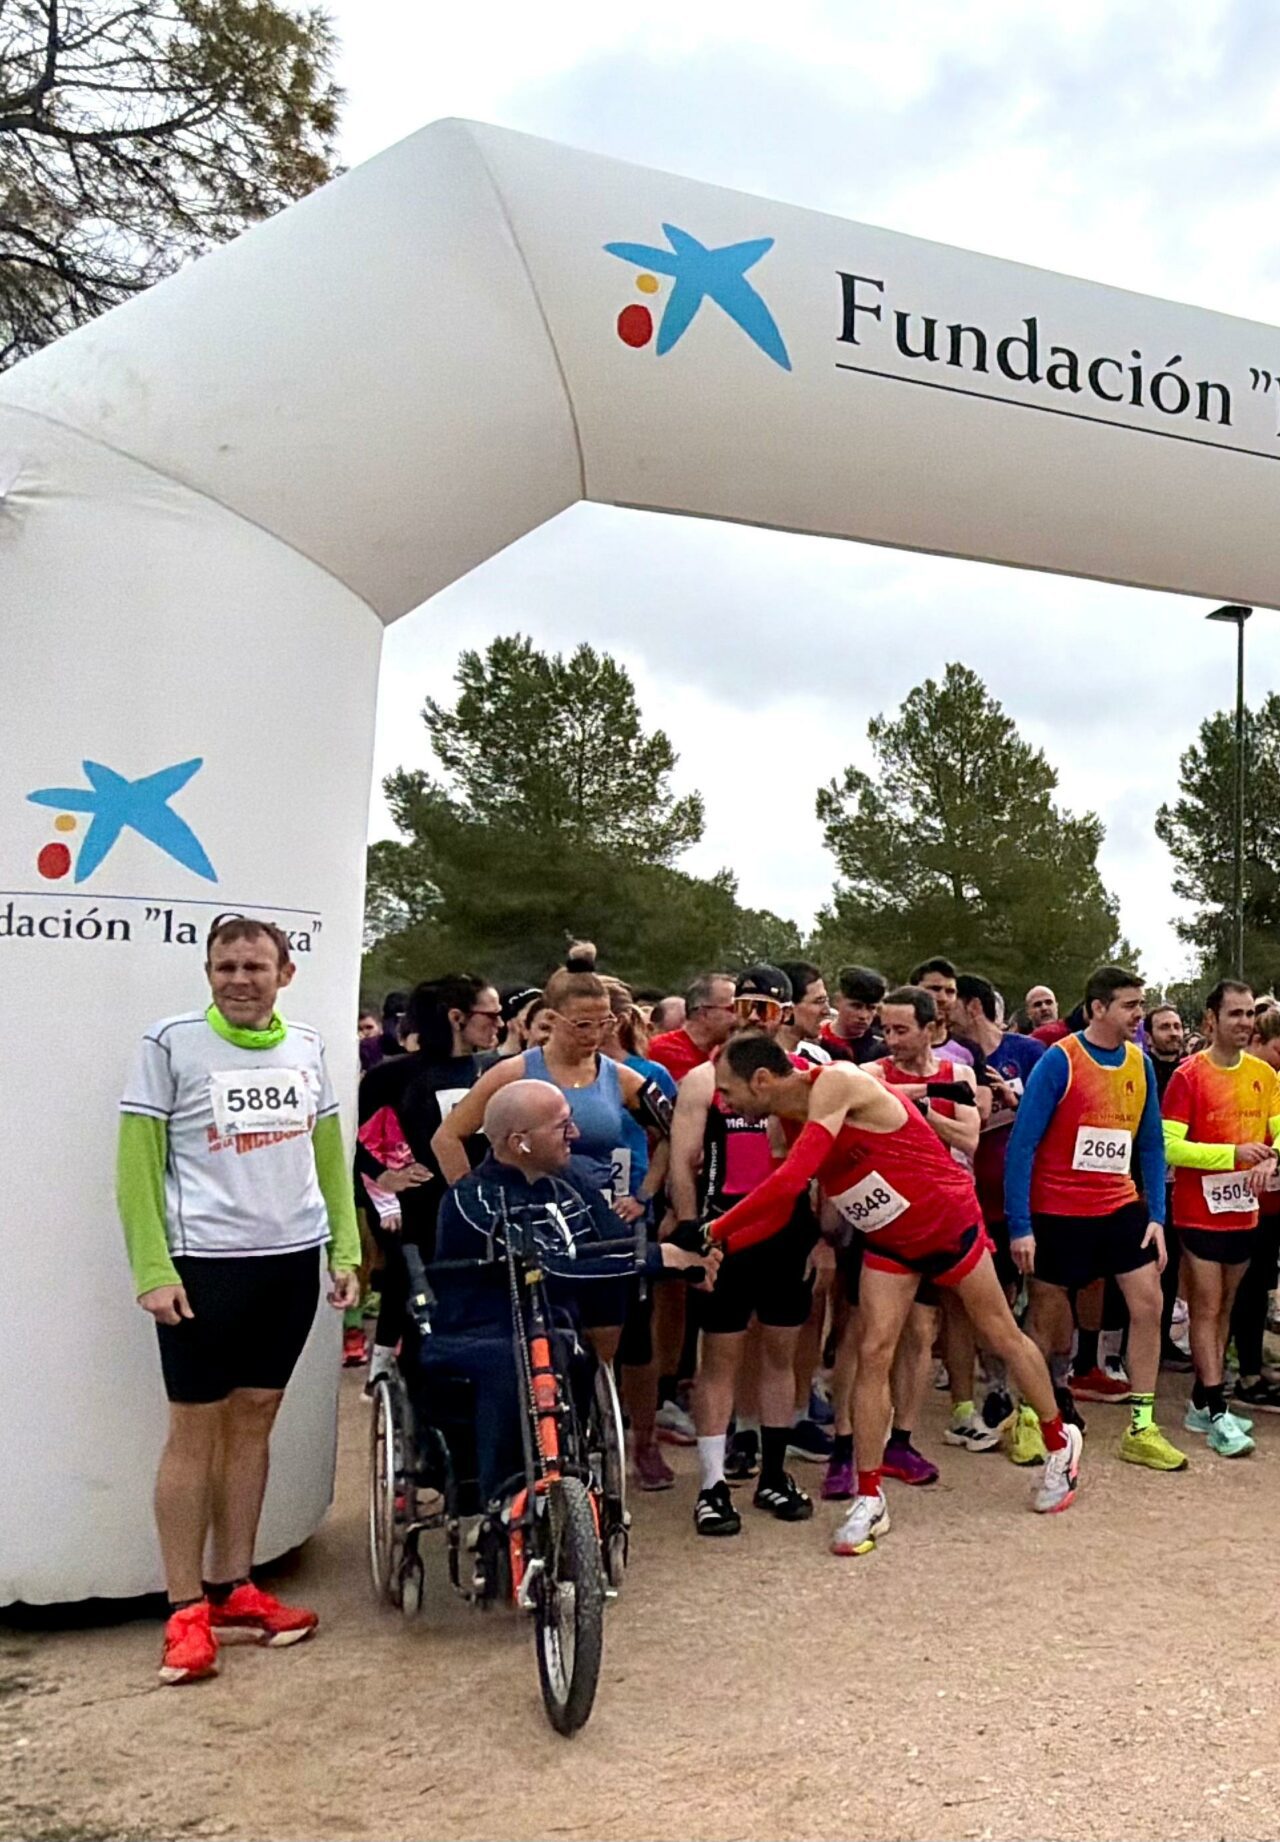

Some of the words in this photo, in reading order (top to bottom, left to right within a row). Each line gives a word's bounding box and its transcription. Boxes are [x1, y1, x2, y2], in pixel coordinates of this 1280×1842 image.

[835, 271, 1233, 426] Fundación
[227, 1085, 299, 1112] 5884
[1082, 1139, 1127, 1159] 2664
[845, 1187, 891, 1221] 5848
